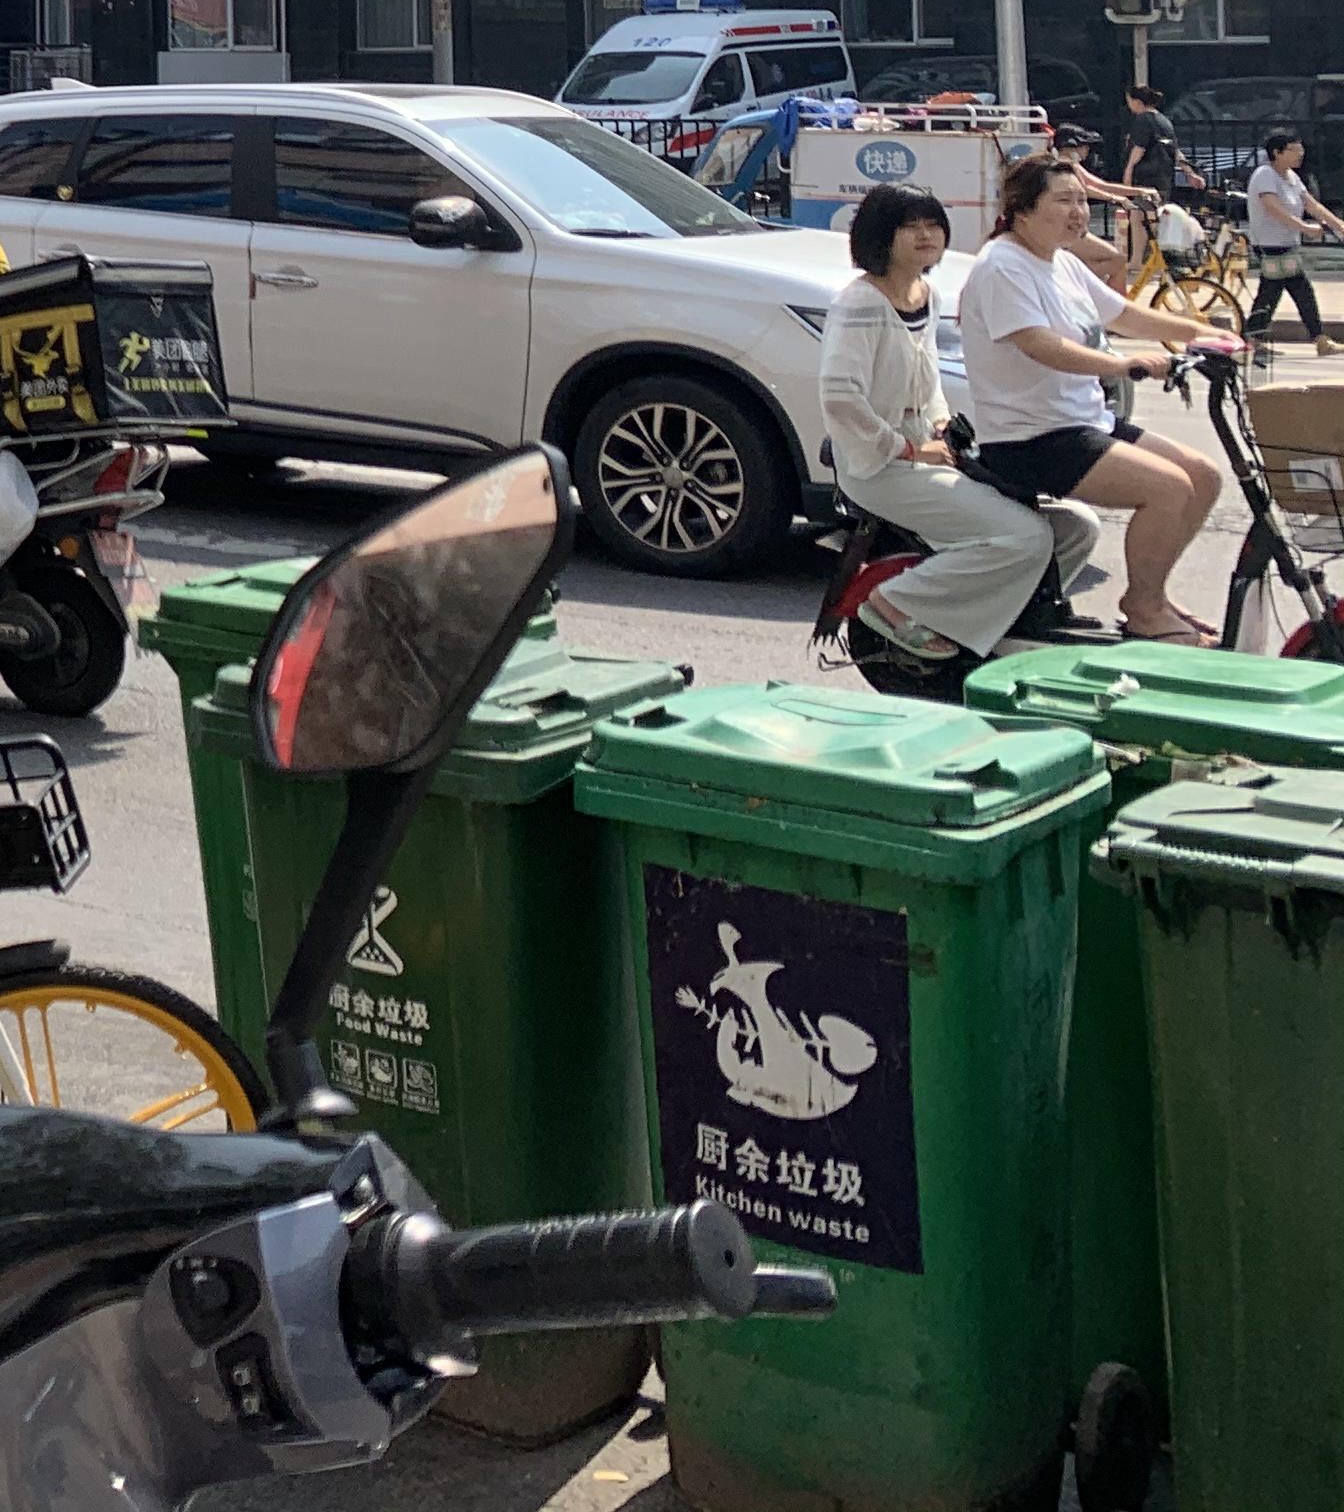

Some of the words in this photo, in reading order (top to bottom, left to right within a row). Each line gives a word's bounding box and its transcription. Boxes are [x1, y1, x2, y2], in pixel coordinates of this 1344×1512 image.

[633, 37, 672, 48] 120
[863, 149, 908, 175] 快递
[336, 1011, 371, 1034] Food
[375, 1021, 423, 1046] Waste
[696, 1122, 865, 1207] 厨余垃圾
[695, 1174, 782, 1223] Kitchen
